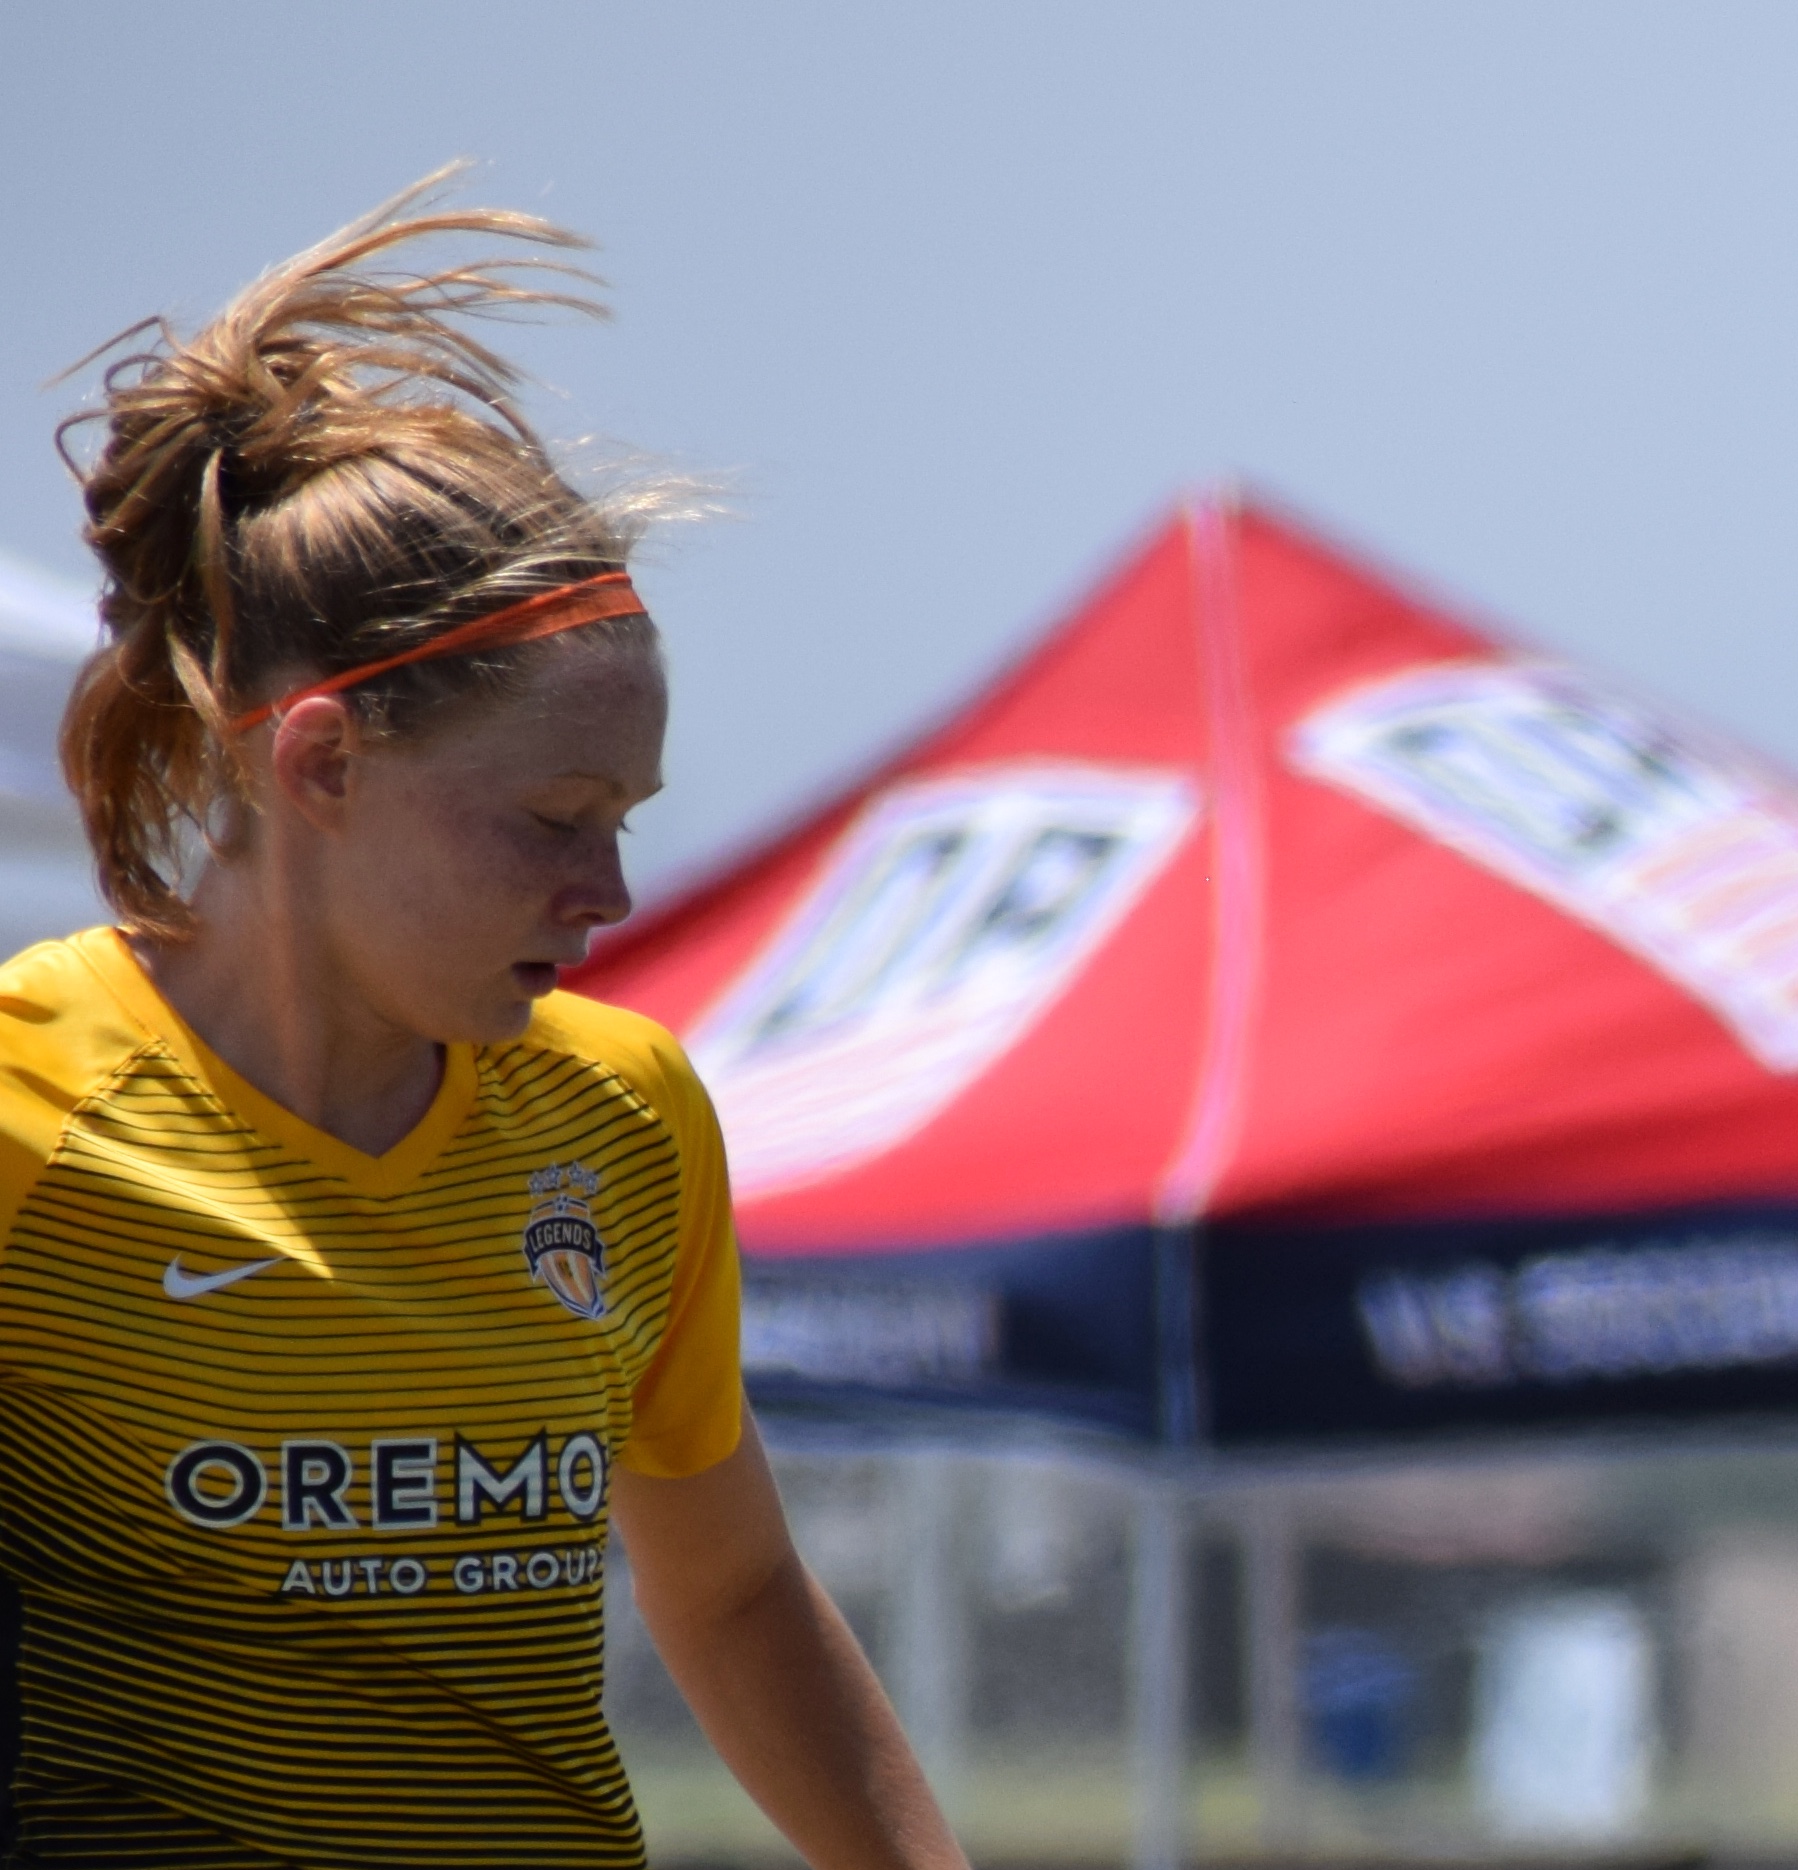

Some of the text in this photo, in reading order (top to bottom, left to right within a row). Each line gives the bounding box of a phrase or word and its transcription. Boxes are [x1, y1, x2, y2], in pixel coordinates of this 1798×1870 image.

[528, 1222, 592, 1253] LEGENDS
[281, 1547, 598, 1595] AUTO GROUP
